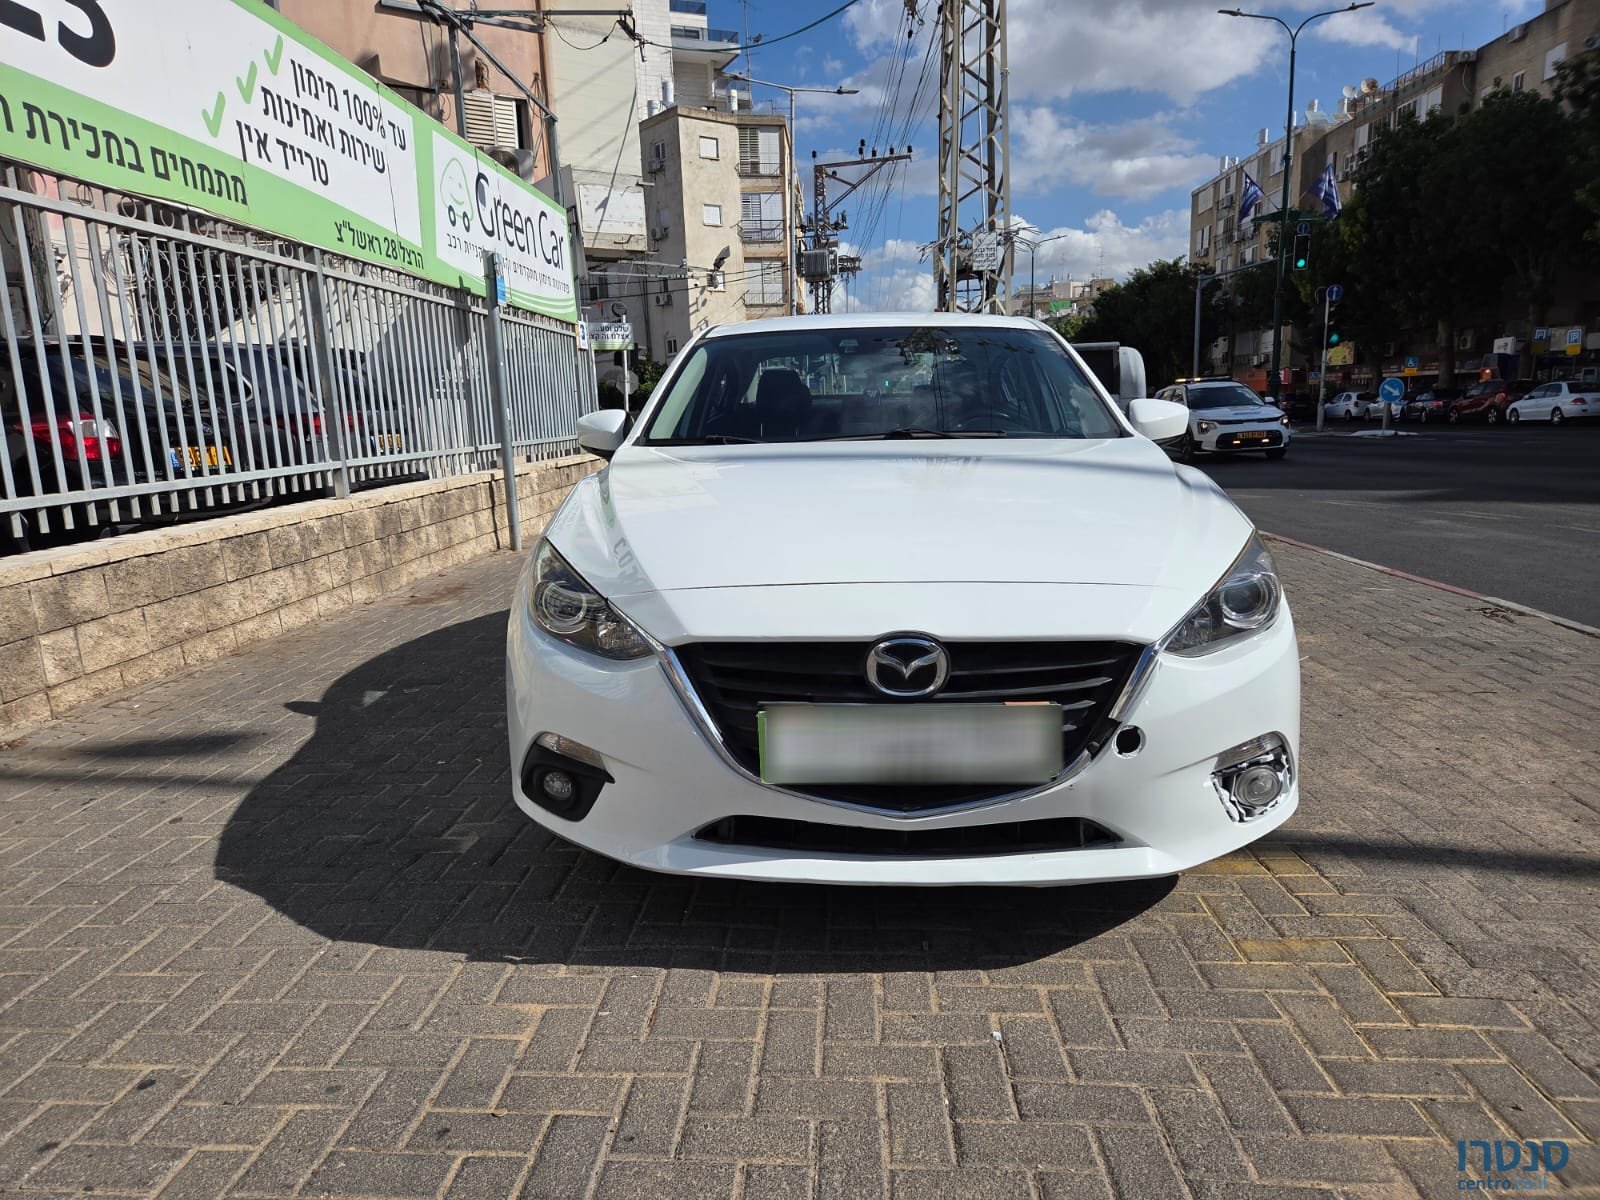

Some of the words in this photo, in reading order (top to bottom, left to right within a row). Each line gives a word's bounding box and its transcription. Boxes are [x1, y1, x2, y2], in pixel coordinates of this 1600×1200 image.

[290, 58, 339, 112] מימון
[22, 101, 145, 174] במכירת
[260, 85, 335, 149] ואמינות
[342, 88, 387, 139] 100%
[387, 119, 407, 151] עד
[235, 119, 272, 163] אין
[276, 137, 329, 186] טרייד
[338, 127, 386, 174] שירות
[150, 145, 248, 206] מתמחים
[446, 233, 462, 251] רכב
[475, 171, 537, 258] Green
[538, 210, 564, 271] Car
[383, 236, 398, 261] 28
[399, 239, 424, 270] הרצל
[464, 240, 484, 263] קניית
